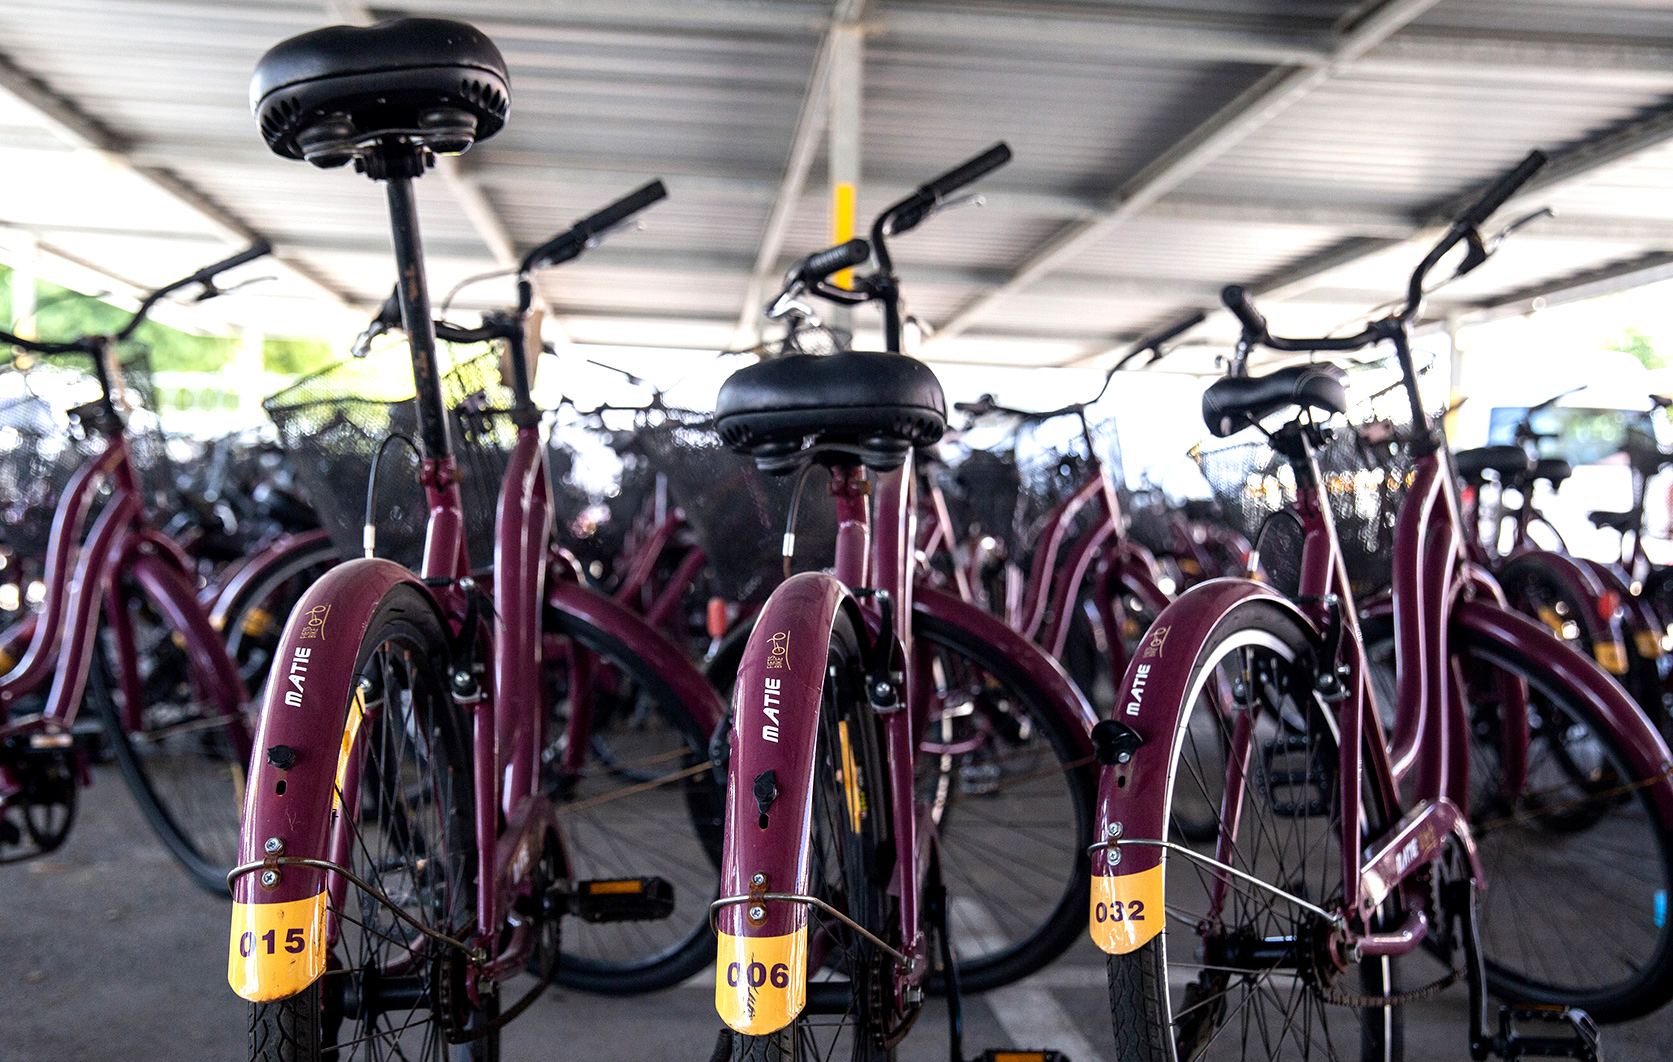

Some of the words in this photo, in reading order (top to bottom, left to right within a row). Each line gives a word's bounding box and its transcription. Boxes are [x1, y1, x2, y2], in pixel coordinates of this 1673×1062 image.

[284, 647, 311, 708] MATIE
[1126, 663, 1151, 716] MATIE
[762, 677, 781, 743] MATIE
[1095, 900, 1145, 923] 032
[239, 928, 306, 958] 015
[727, 961, 789, 989] 006
